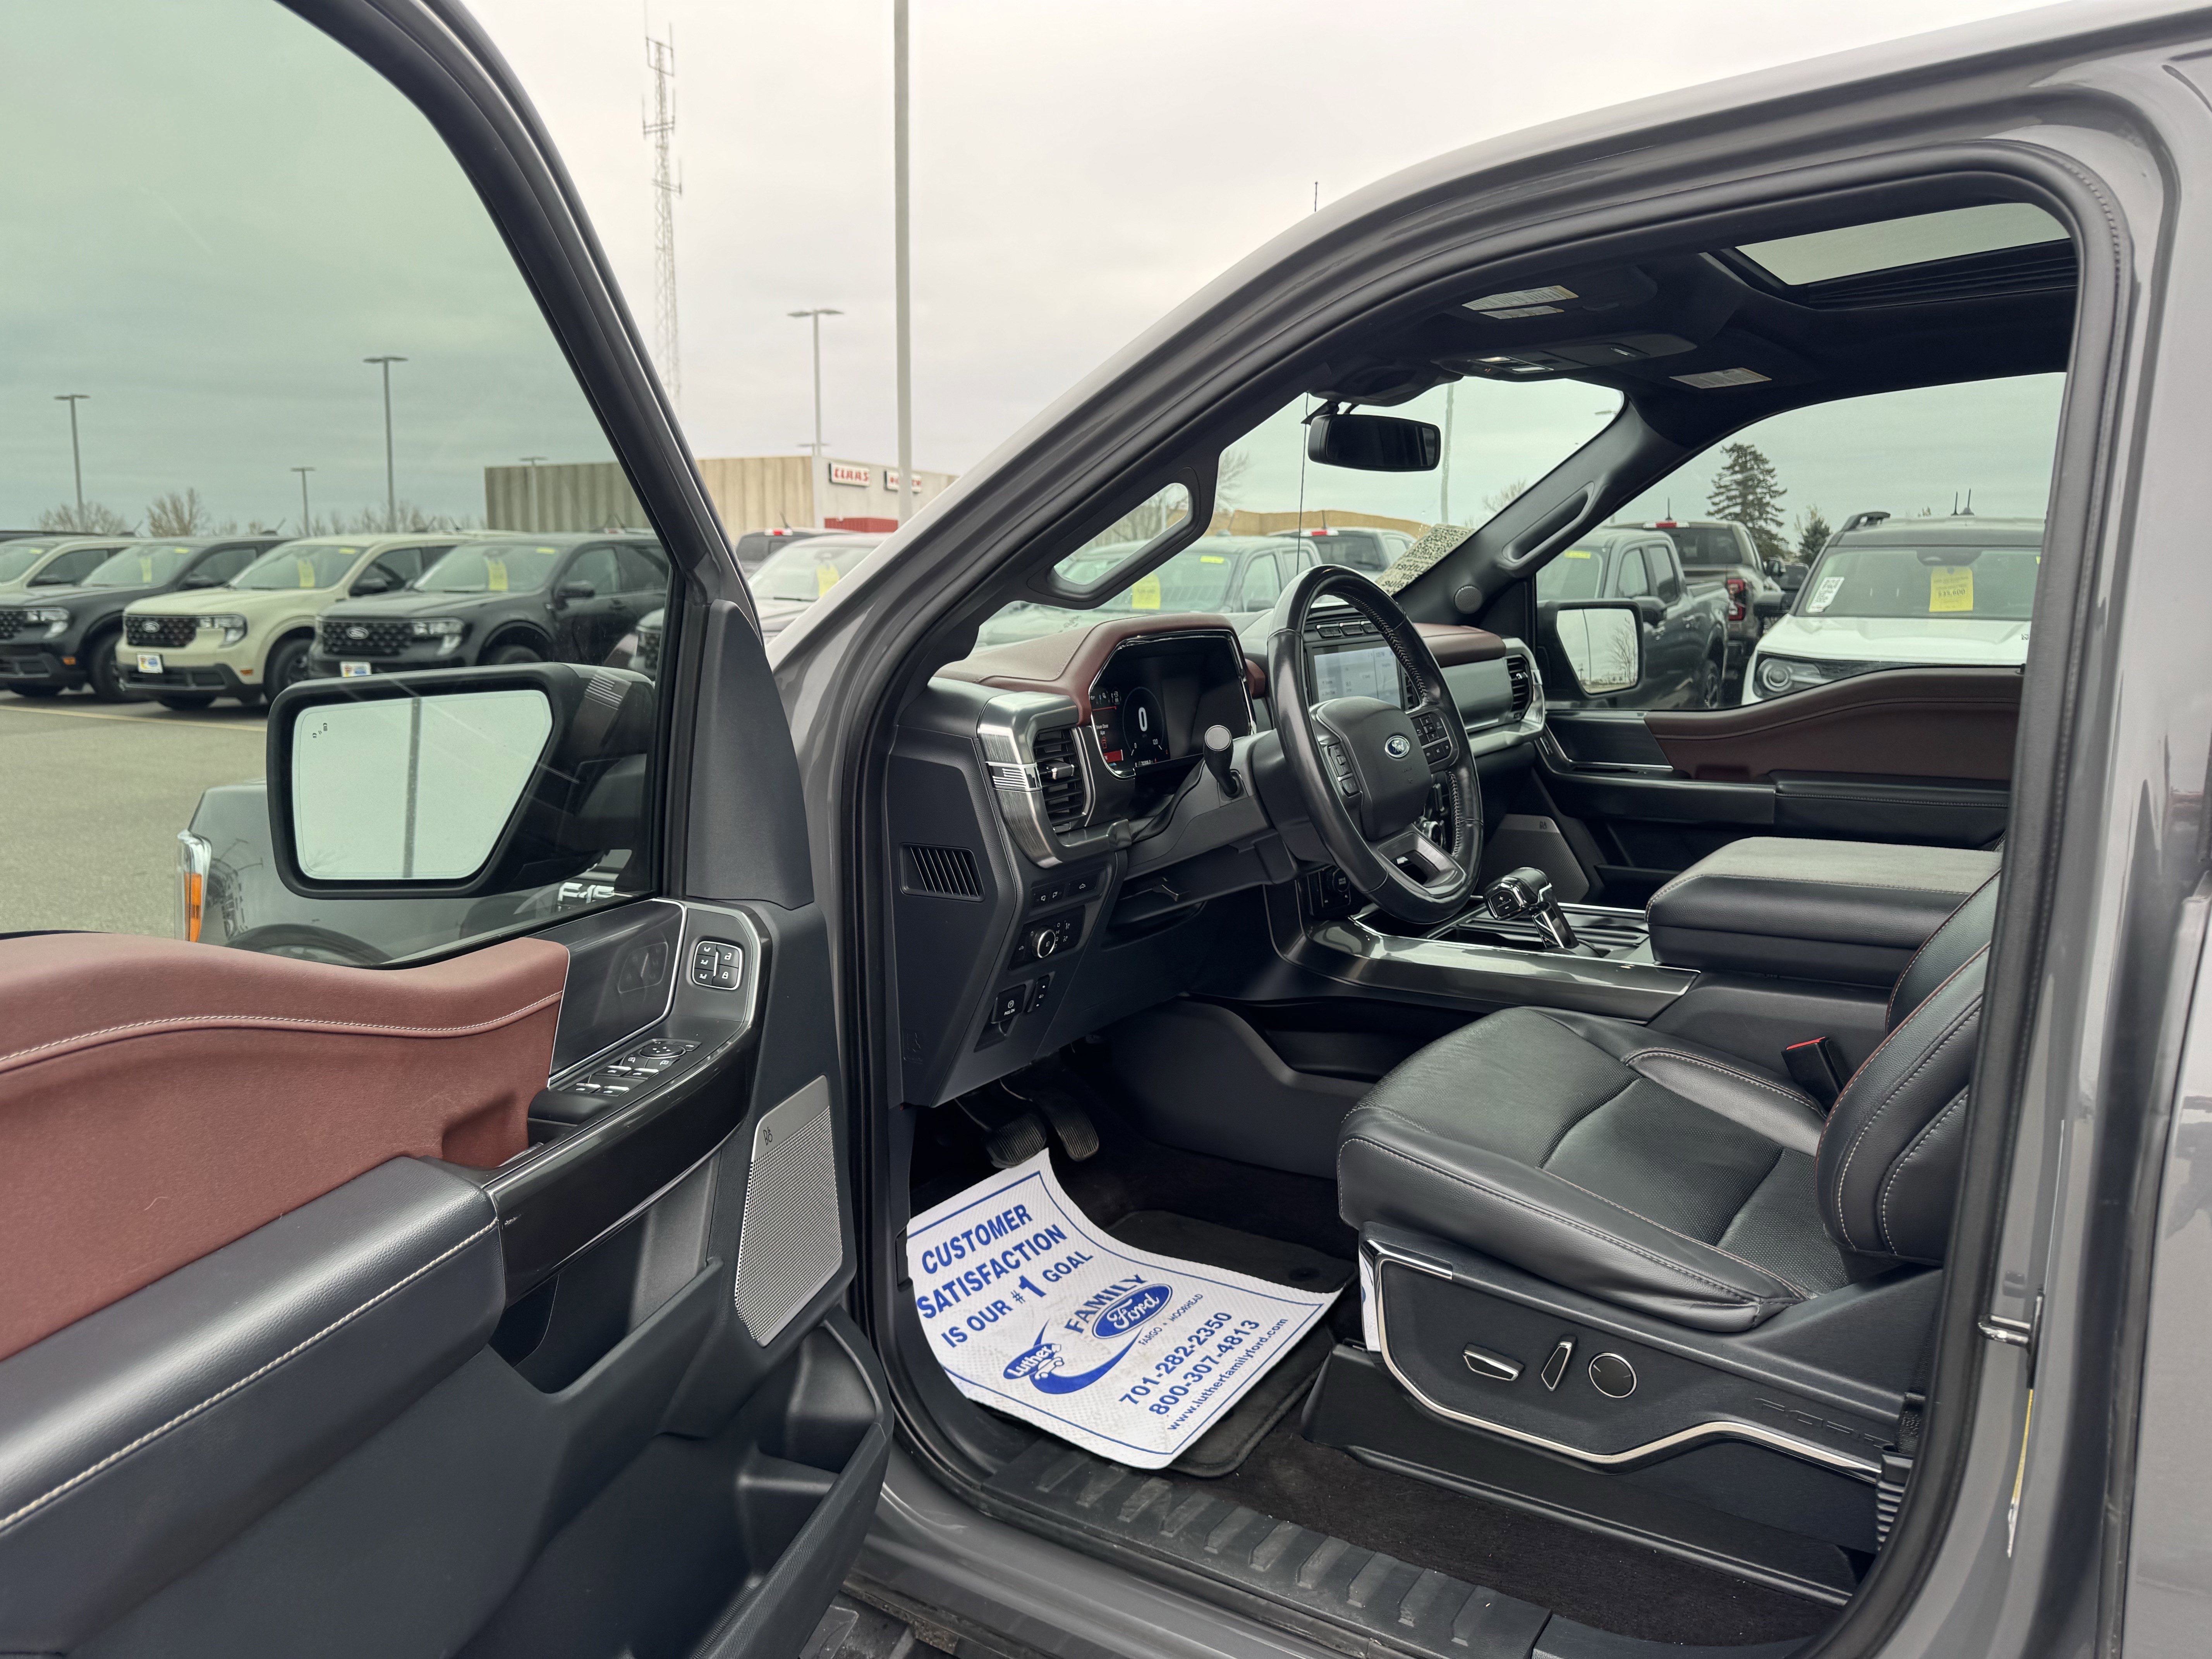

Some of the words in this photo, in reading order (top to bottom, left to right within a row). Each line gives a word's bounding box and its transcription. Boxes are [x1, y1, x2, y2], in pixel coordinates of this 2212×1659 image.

[835, 467, 868, 481] CLAAS
[1139, 707, 1147, 732] 0
[558, 882, 615, 903] F-15
[922, 1204, 1033, 1274] CUSTOMER
[917, 1224, 1068, 1319] SATISFACTION
[941, 1326, 968, 1348] IS
[967, 1299, 1013, 1331] OUR
[1042, 1251, 1094, 1282] GOAL
[1064, 1274, 1148, 1333] FAMILY
[1107, 1292, 1160, 1329] Ford
[1168, 1293, 1204, 1322] MOORHEAD
[1118, 1312, 1232, 1405] 701-282-2350
[1138, 1326, 1163, 1345] FARGO
[1007, 1346, 1052, 1377] Luther
[1149, 1319, 1260, 1415] 800-307-4813
[1167, 1319, 1289, 1431] www.lutherfamilyford.com
